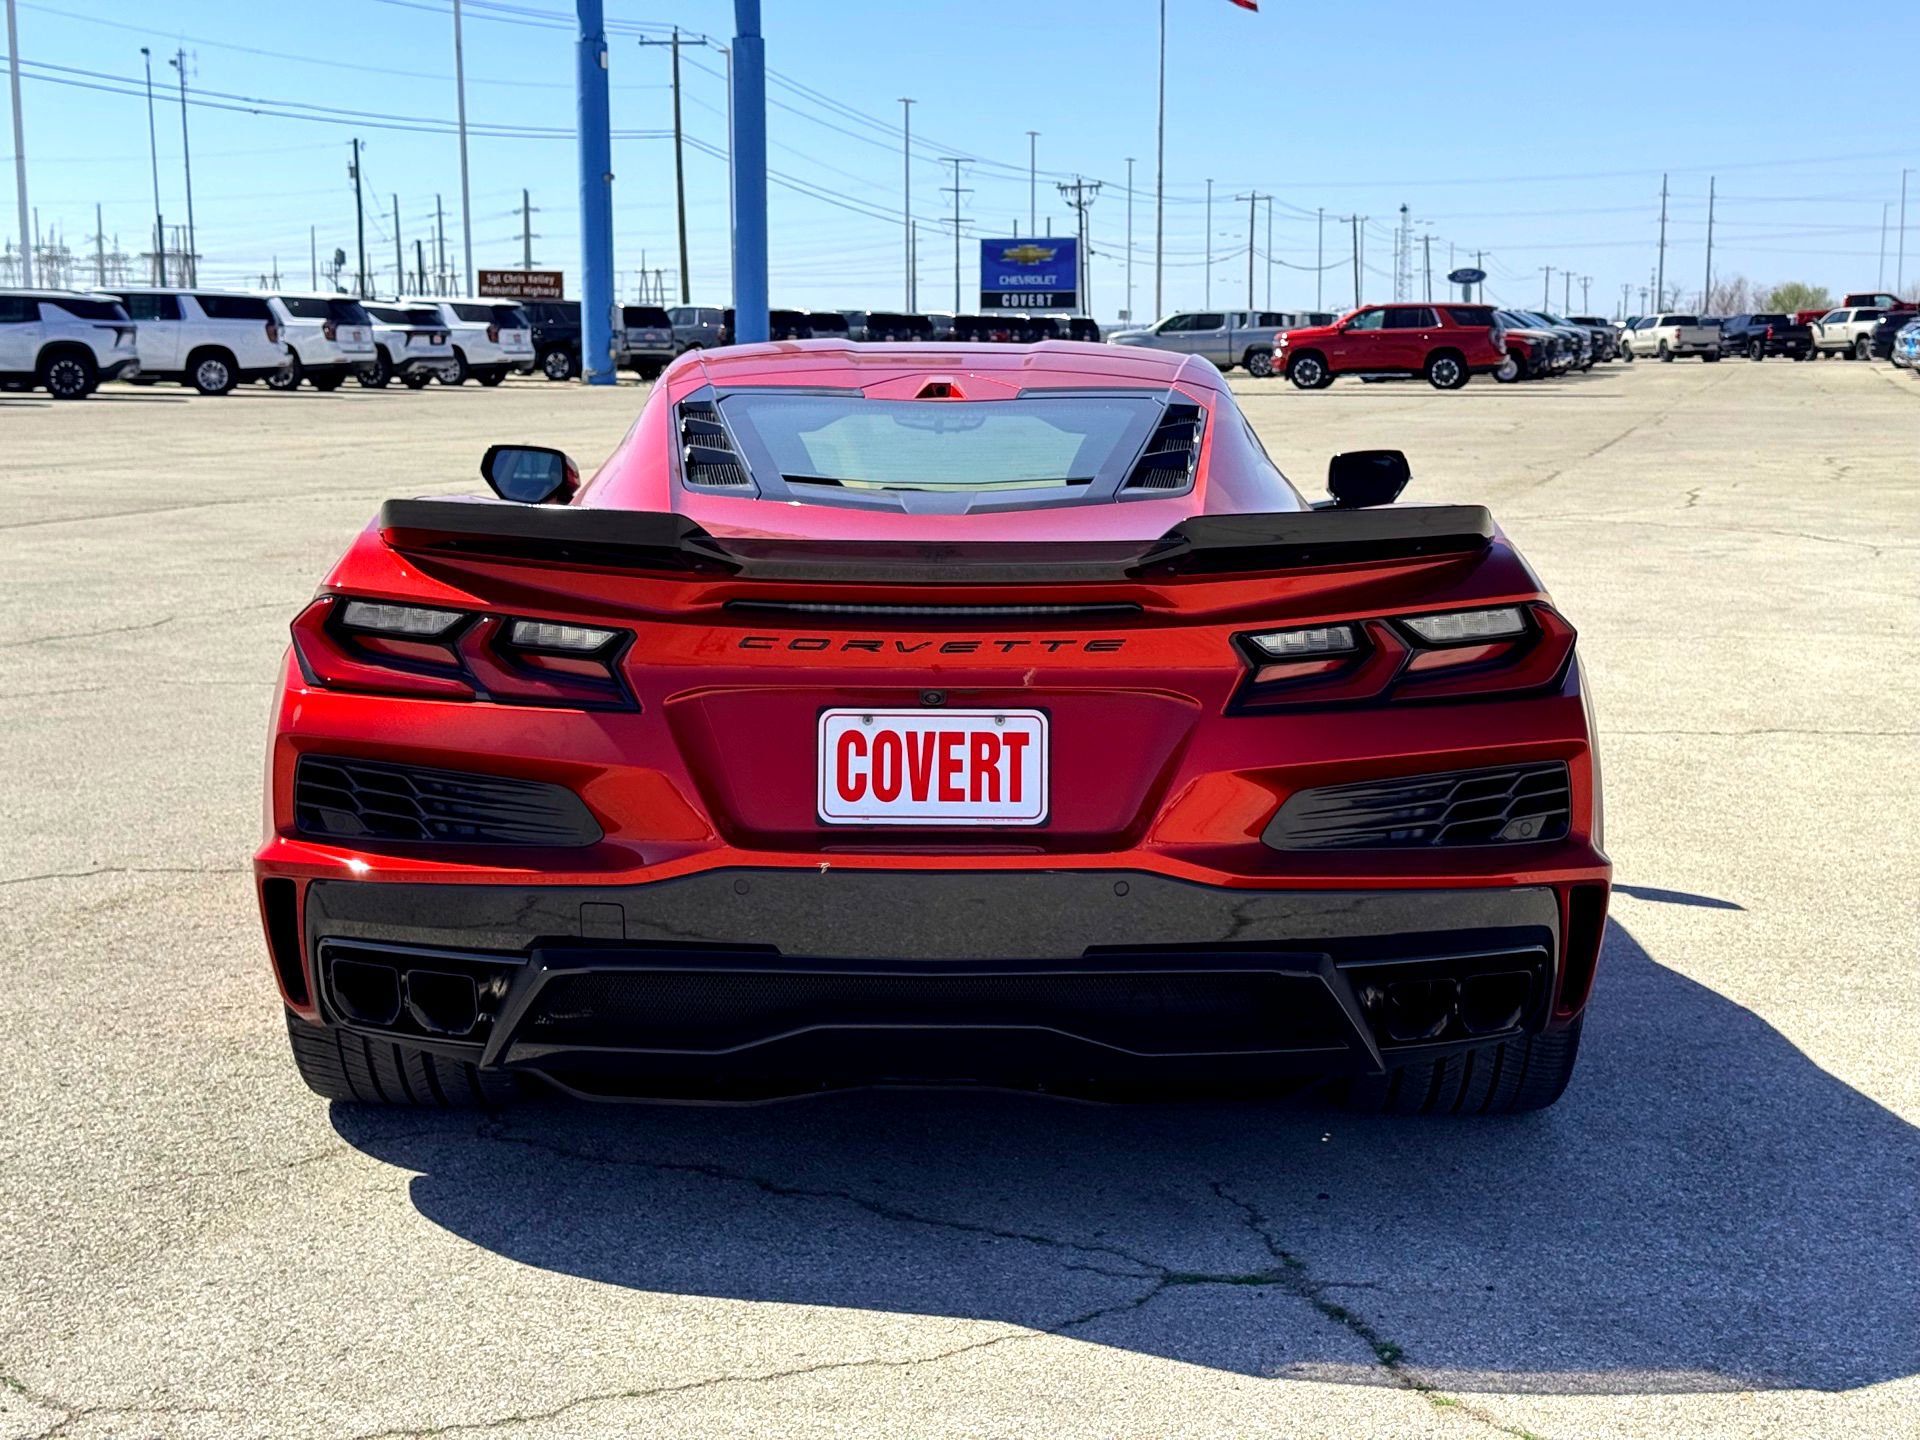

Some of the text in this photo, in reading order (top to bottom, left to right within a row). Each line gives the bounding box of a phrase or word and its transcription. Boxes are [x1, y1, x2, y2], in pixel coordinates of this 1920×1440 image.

[503, 273, 526, 284] Chris
[998, 275, 1057, 285] CHEVROLET
[481, 285, 560, 297] Memorial Highway
[1001, 294, 1053, 307] COVERT
[738, 636, 1127, 654] CORVETTE
[836, 729, 1030, 803] COVERT
